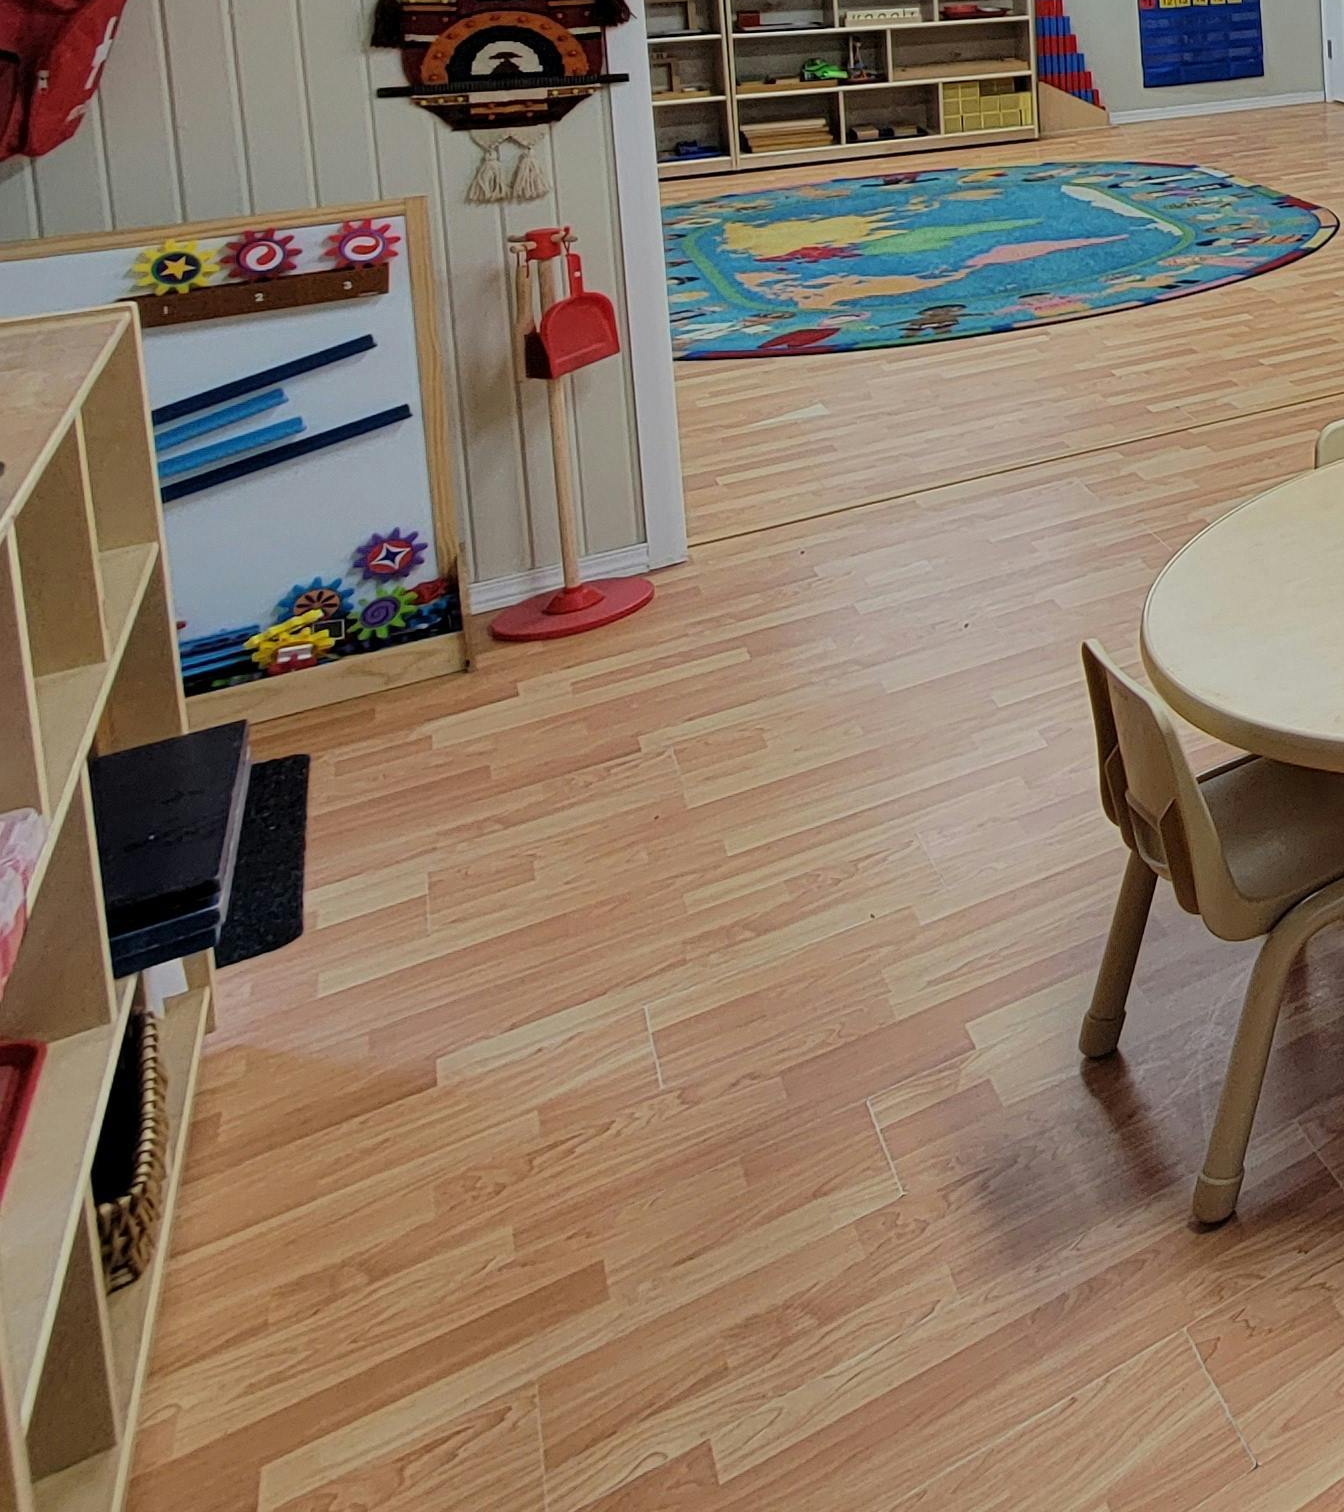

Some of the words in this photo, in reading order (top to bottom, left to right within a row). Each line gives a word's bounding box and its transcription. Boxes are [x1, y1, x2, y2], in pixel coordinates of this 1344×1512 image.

[162, 305, 170, 315] 1
[254, 292, 264, 302] 2
[343, 280, 353, 290] 3
